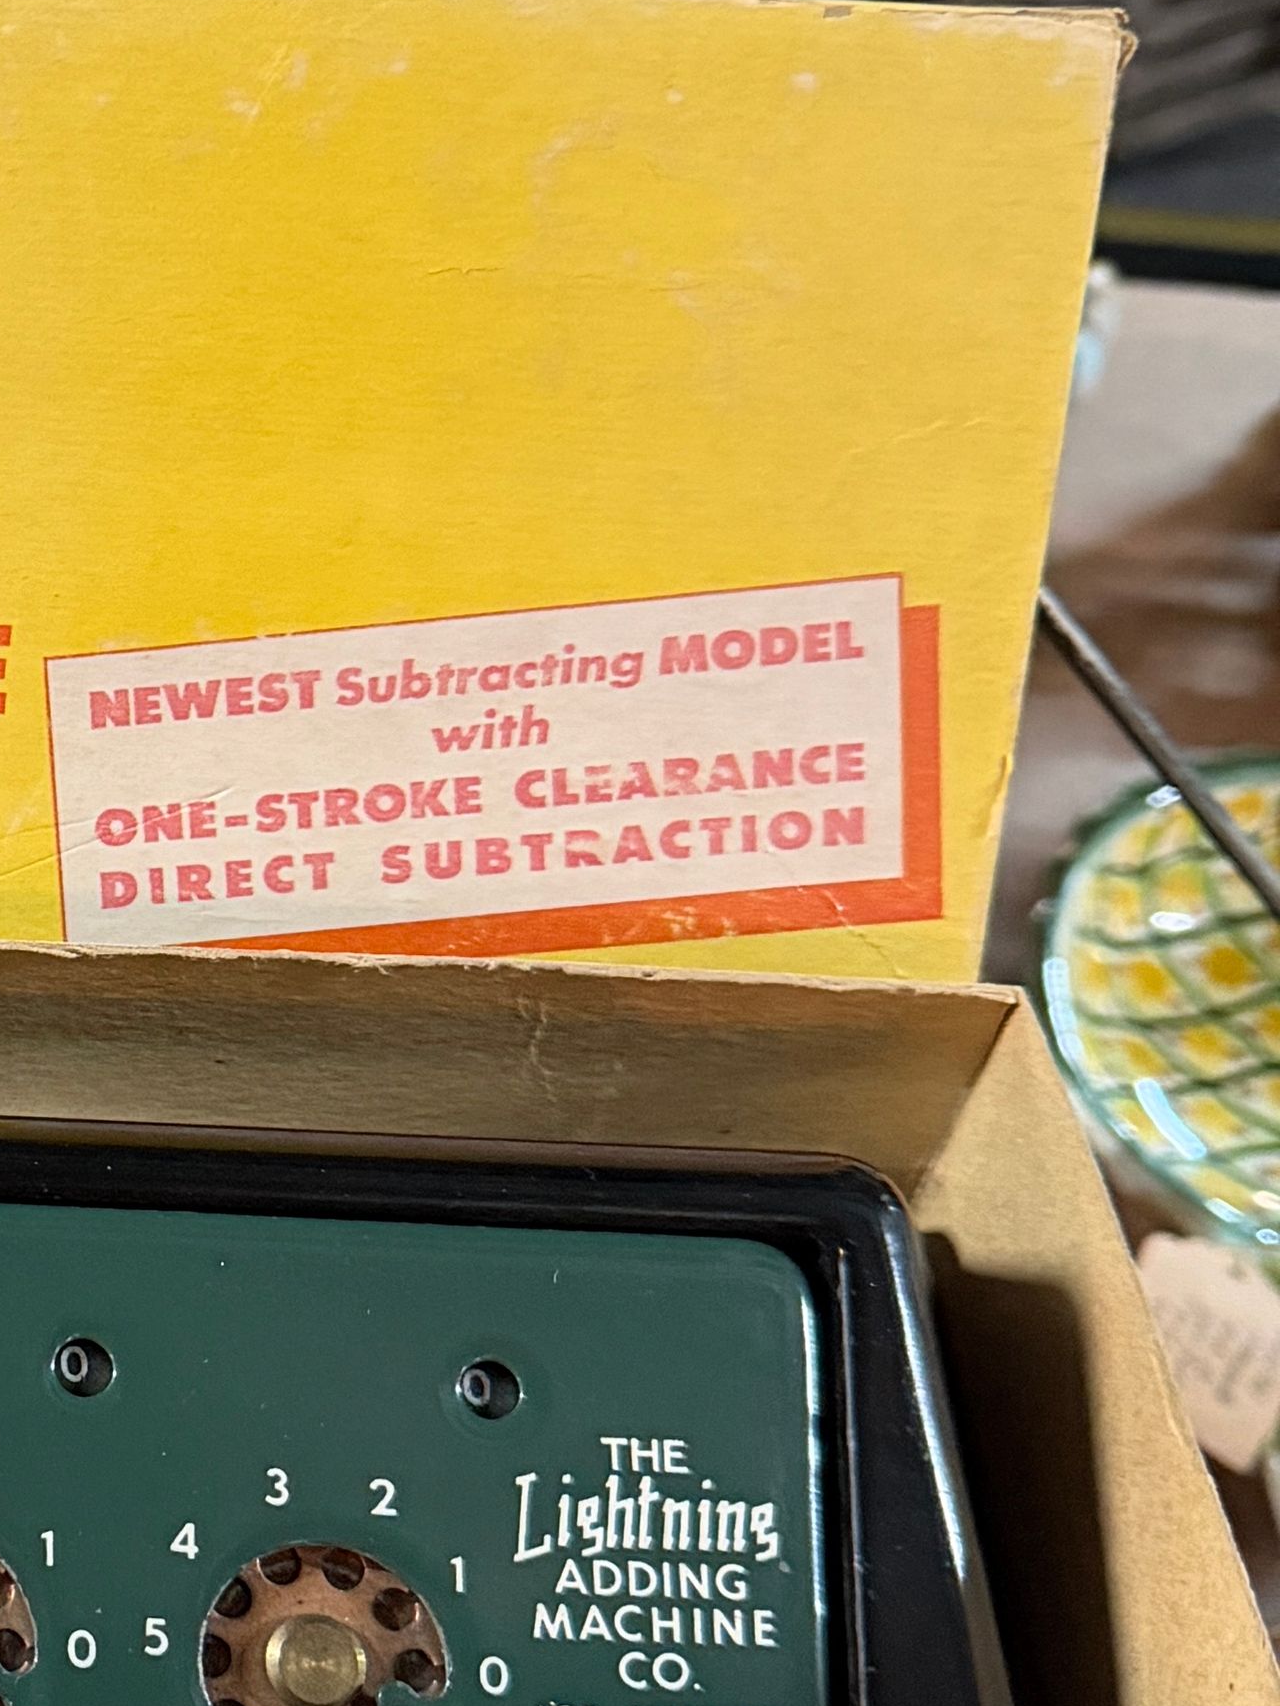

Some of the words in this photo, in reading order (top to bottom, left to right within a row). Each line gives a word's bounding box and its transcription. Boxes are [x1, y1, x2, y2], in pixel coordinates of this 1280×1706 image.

[89, 670, 321, 730] NEWEST
[336, 645, 643, 708] Subtracting
[659, 620, 864, 676] MODEL
[432, 704, 549, 753] with
[95, 776, 482, 848] ONE-STROKE
[514, 742, 865, 807] CLEARANCE
[100, 852, 335, 909] DIRECT
[380, 806, 865, 884] SUBTRACTION
[60, 1346, 88, 1383] 0
[461, 1368, 490, 1407] 0
[600, 1437, 690, 1474] THE
[265, 1467, 290, 1507] 3
[369, 1478, 398, 1517] 2
[513, 1471, 781, 1562] Lightning
[40, 1530, 54, 1567] 1
[169, 1522, 199, 1560] 4
[450, 1556, 464, 1593] 1
[555, 1559, 747, 1601] ADDING
[144, 1617, 169, 1656] 5
[534, 1603, 776, 1646] MACHINE
[67, 1629, 97, 1669] 0
[479, 1656, 509, 1696] 0
[619, 1652, 700, 1690] CO.
